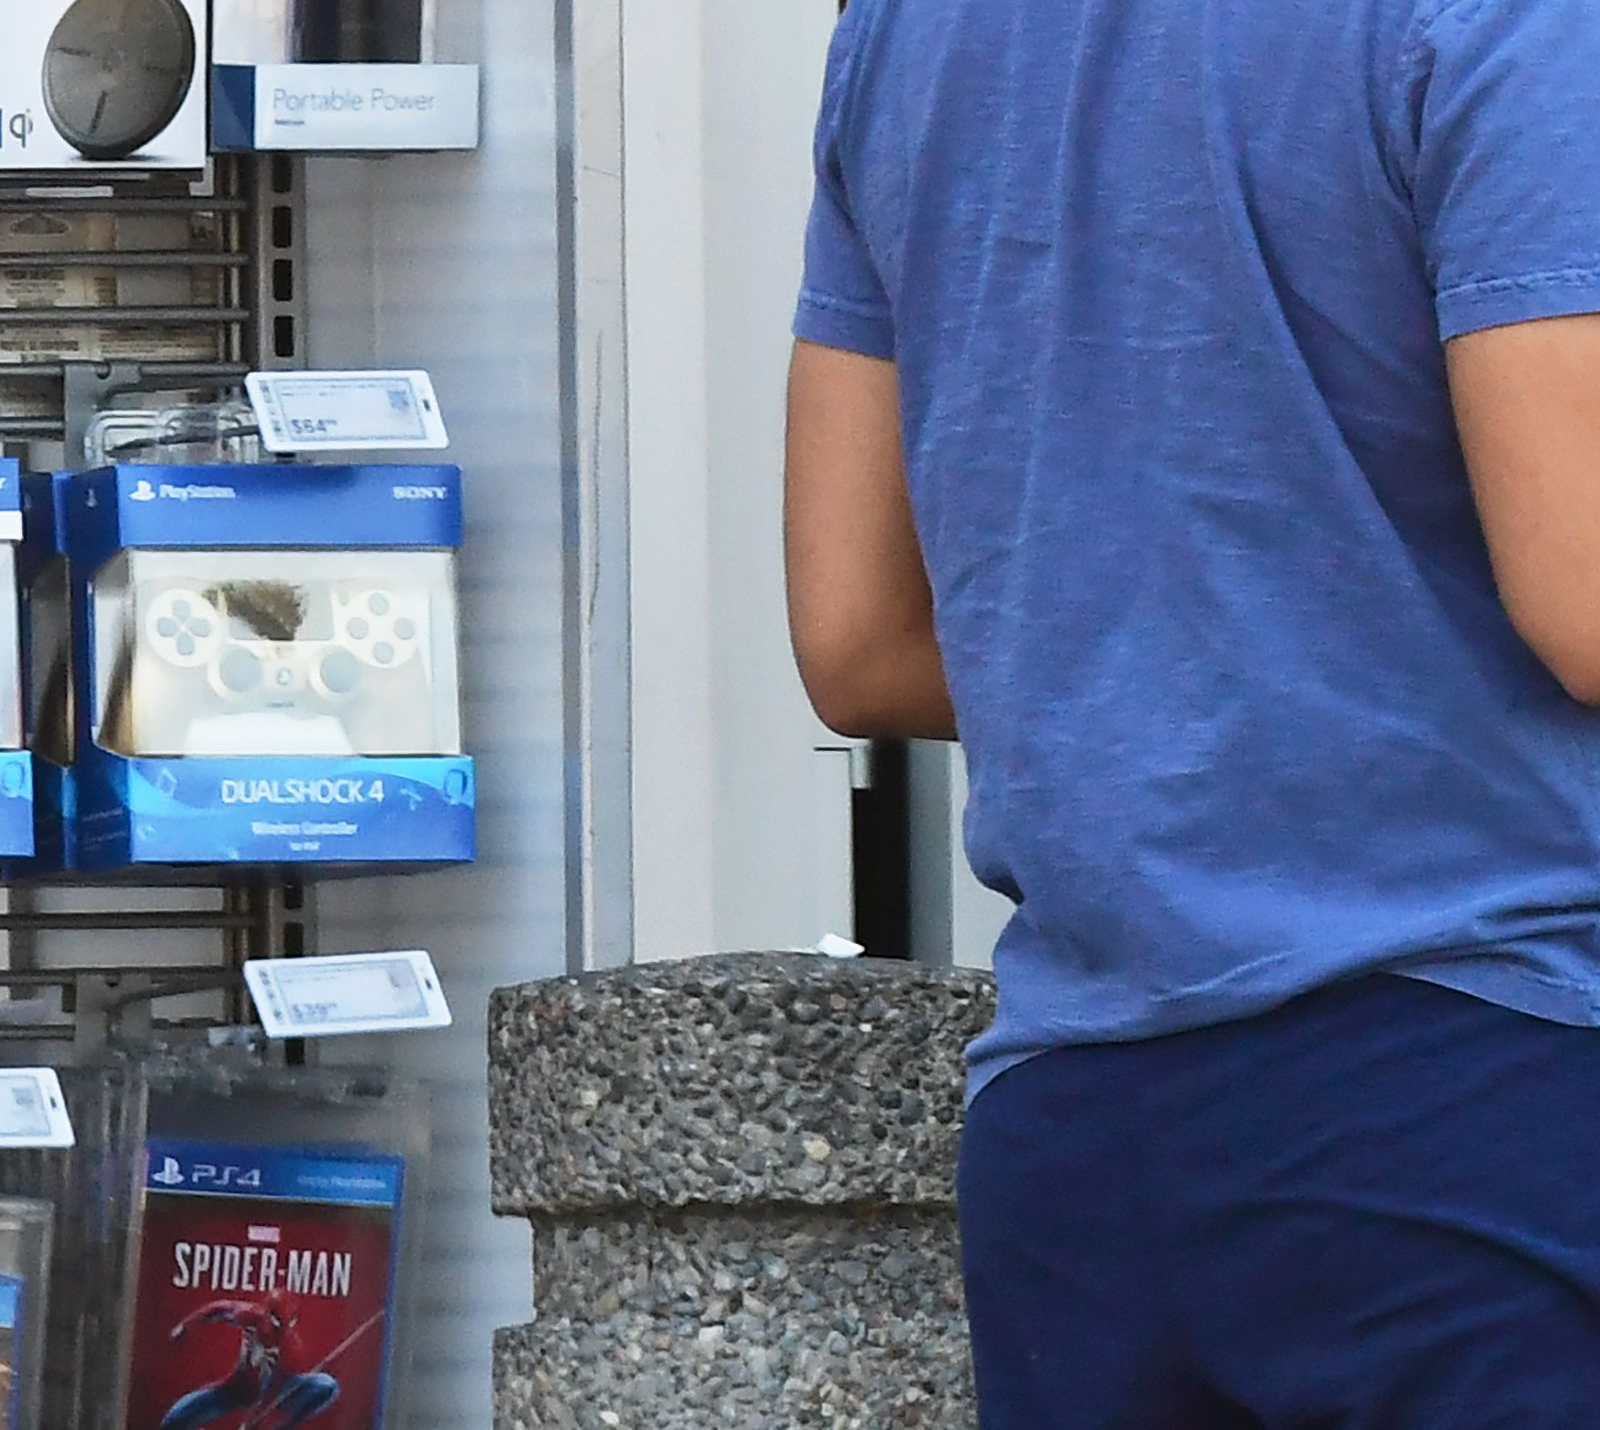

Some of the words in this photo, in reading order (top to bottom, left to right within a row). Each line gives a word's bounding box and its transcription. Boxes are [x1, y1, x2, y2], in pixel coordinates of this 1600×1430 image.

[273, 87, 363, 112] Portable
[371, 87, 437, 112] Power
[393, 485, 449, 500] SONY
[221, 779, 364, 804] DUALSHOCK
[368, 780, 385, 803] 4
[192, 1164, 262, 1187] PS4
[172, 1242, 352, 1298] SPIDER-MAN
